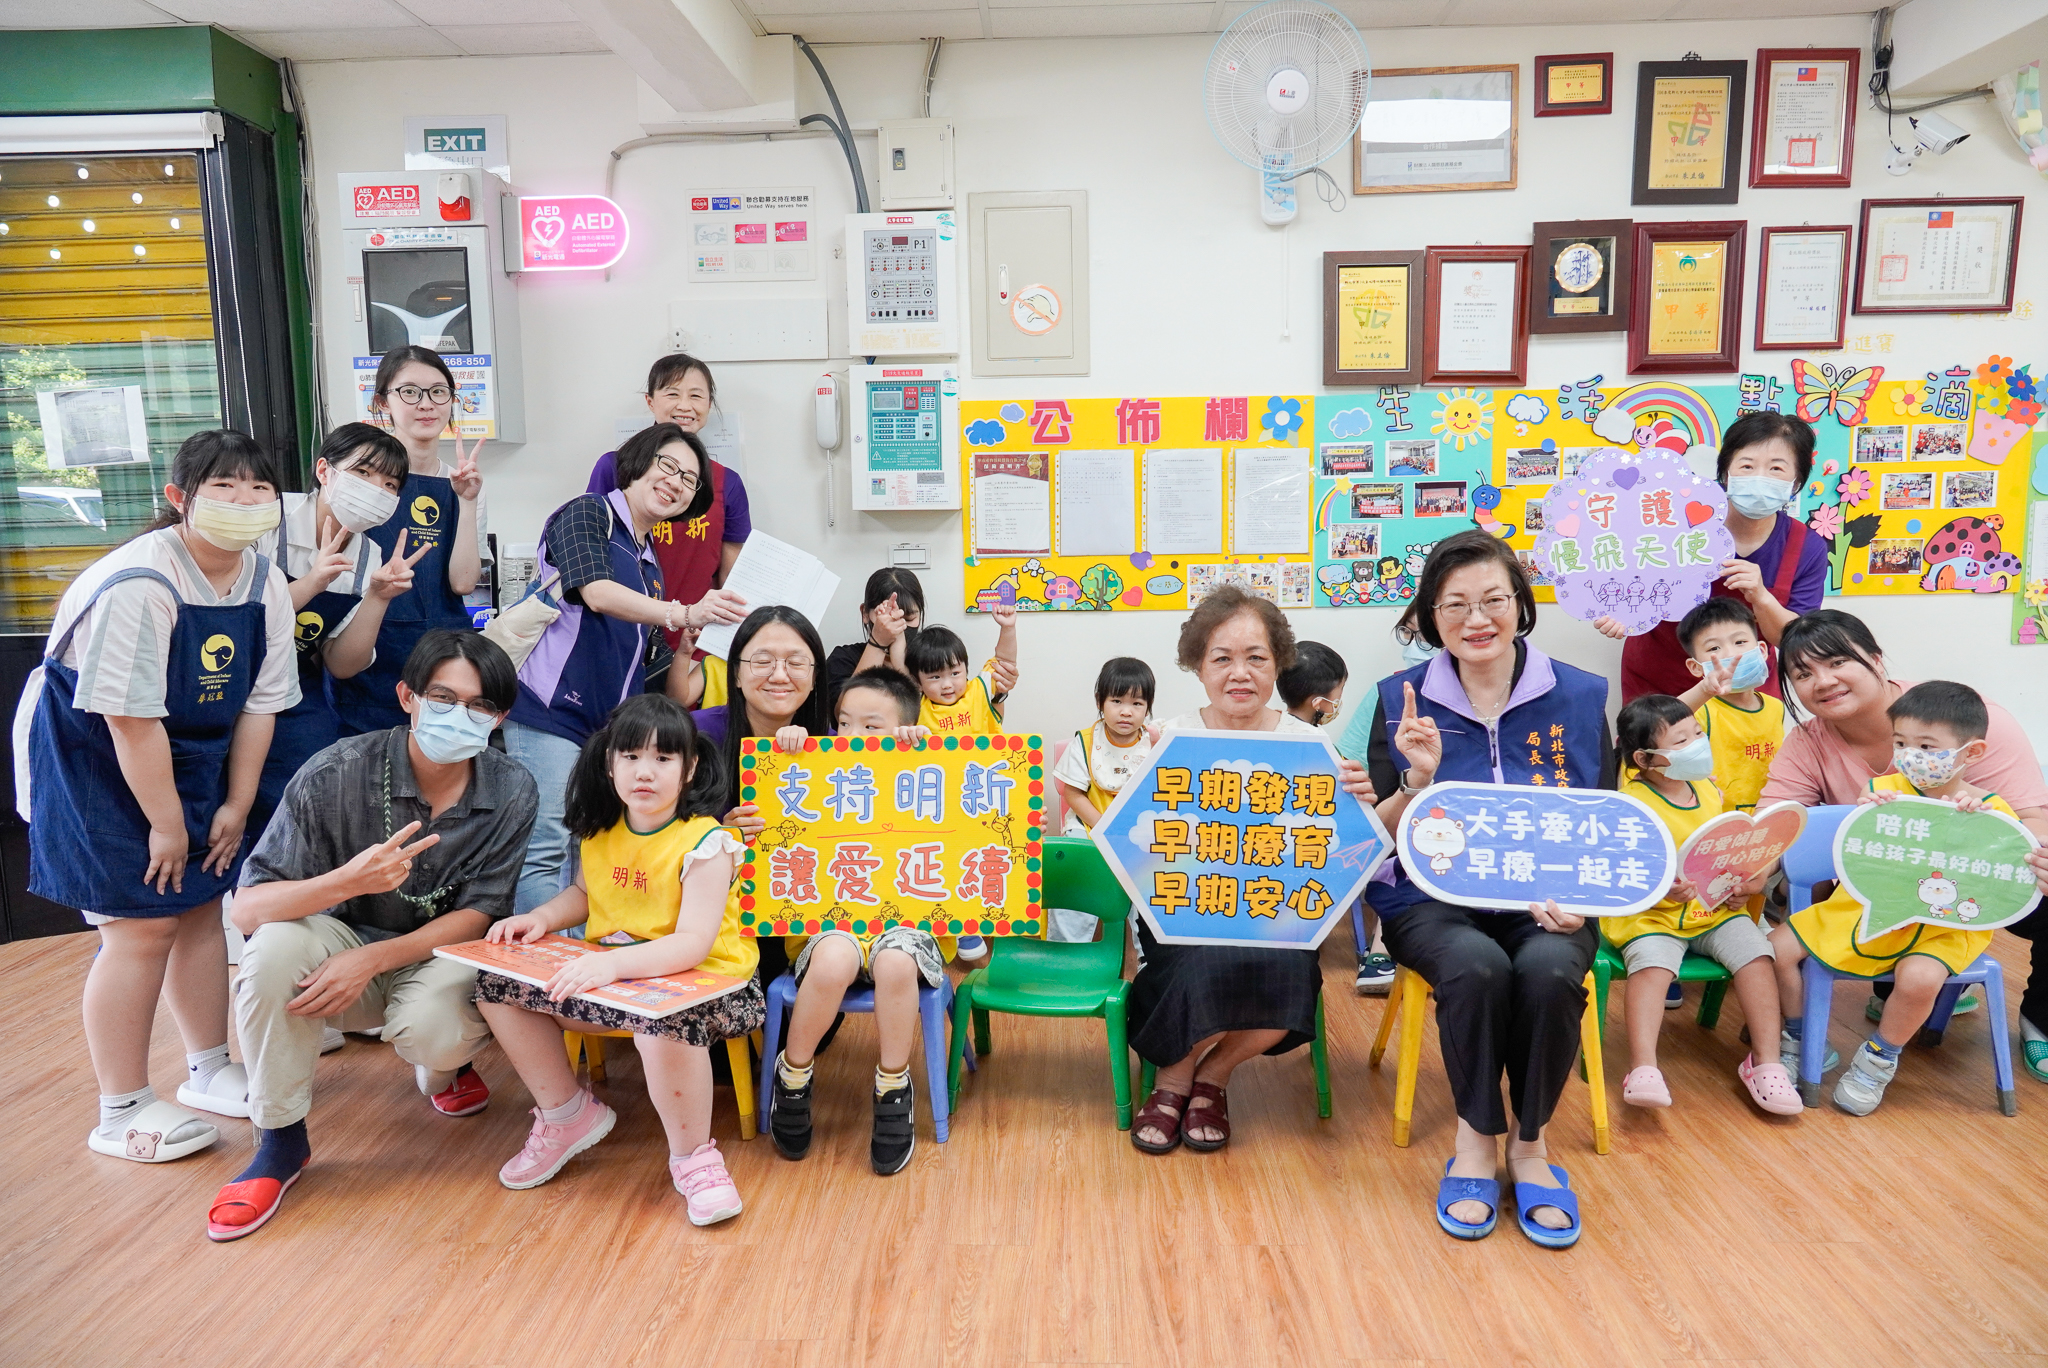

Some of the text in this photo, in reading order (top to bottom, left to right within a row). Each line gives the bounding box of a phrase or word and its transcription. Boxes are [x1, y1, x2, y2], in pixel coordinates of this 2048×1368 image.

[427, 135, 482, 151] EXIT
[377, 187, 416, 201] AED
[535, 206, 560, 216] AED
[571, 213, 615, 230] AED
[1665, 302, 1709, 320] 甲等
[1028, 397, 1248, 445] 公佈欄
[1588, 489, 1677, 529] 守護
[652, 514, 711, 545] 明新
[1551, 532, 1713, 573] 慢飛天使
[938, 711, 972, 731] 明新
[1745, 742, 1775, 760] 明新
[777, 762, 1014, 822] 支持明新
[1152, 767, 1336, 817] 早期發現
[1465, 808, 1649, 848] 大手牽小手
[1694, 827, 1770, 856] 用愛傾聽
[1875, 813, 1932, 842] 陪伴
[1150, 819, 1333, 869] 早期療育
[1710, 841, 1785, 870] 用心陪伴
[770, 844, 1011, 906] 讓愛延續
[1466, 848, 1650, 890] 早療一起走
[1844, 837, 2037, 885] 是給孩子最好的禮物
[612, 866, 648, 894] 明新
[1150, 871, 1335, 920] 早期安心
